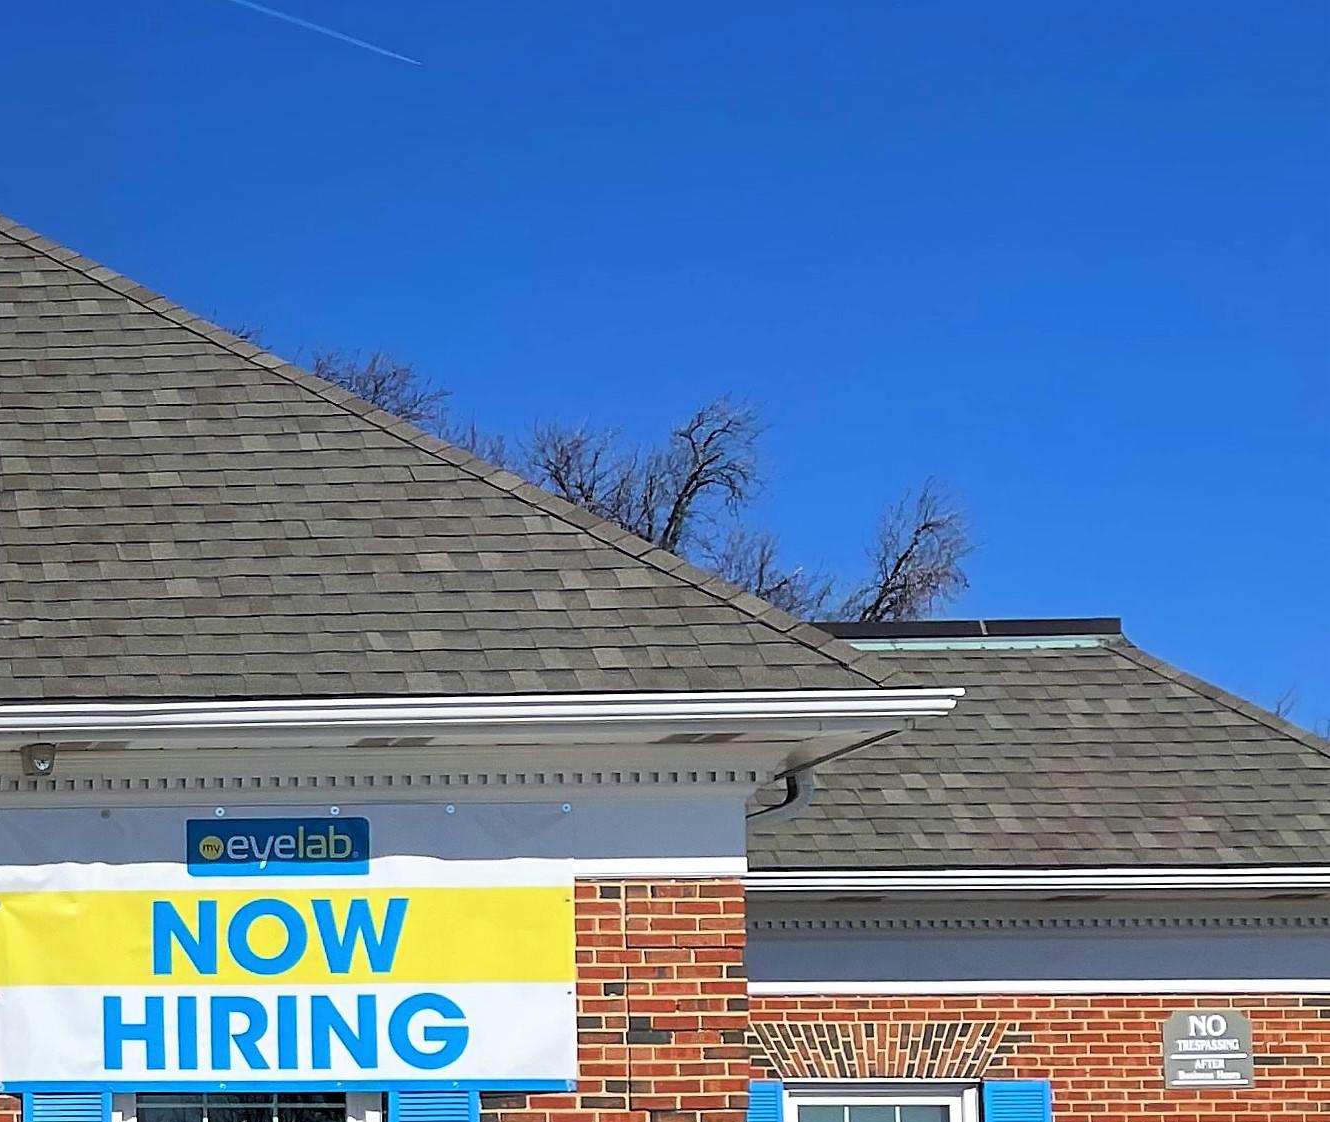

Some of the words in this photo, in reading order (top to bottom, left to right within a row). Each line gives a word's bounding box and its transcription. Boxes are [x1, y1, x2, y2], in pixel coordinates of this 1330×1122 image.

[153, 898, 409, 975] NOW
[103, 992, 470, 1071] HIRING
[1188, 1014, 1227, 1037] NO
[1176, 1038, 1240, 1052] TRESPASSING
[1194, 1059, 1225, 1070] AFTER
